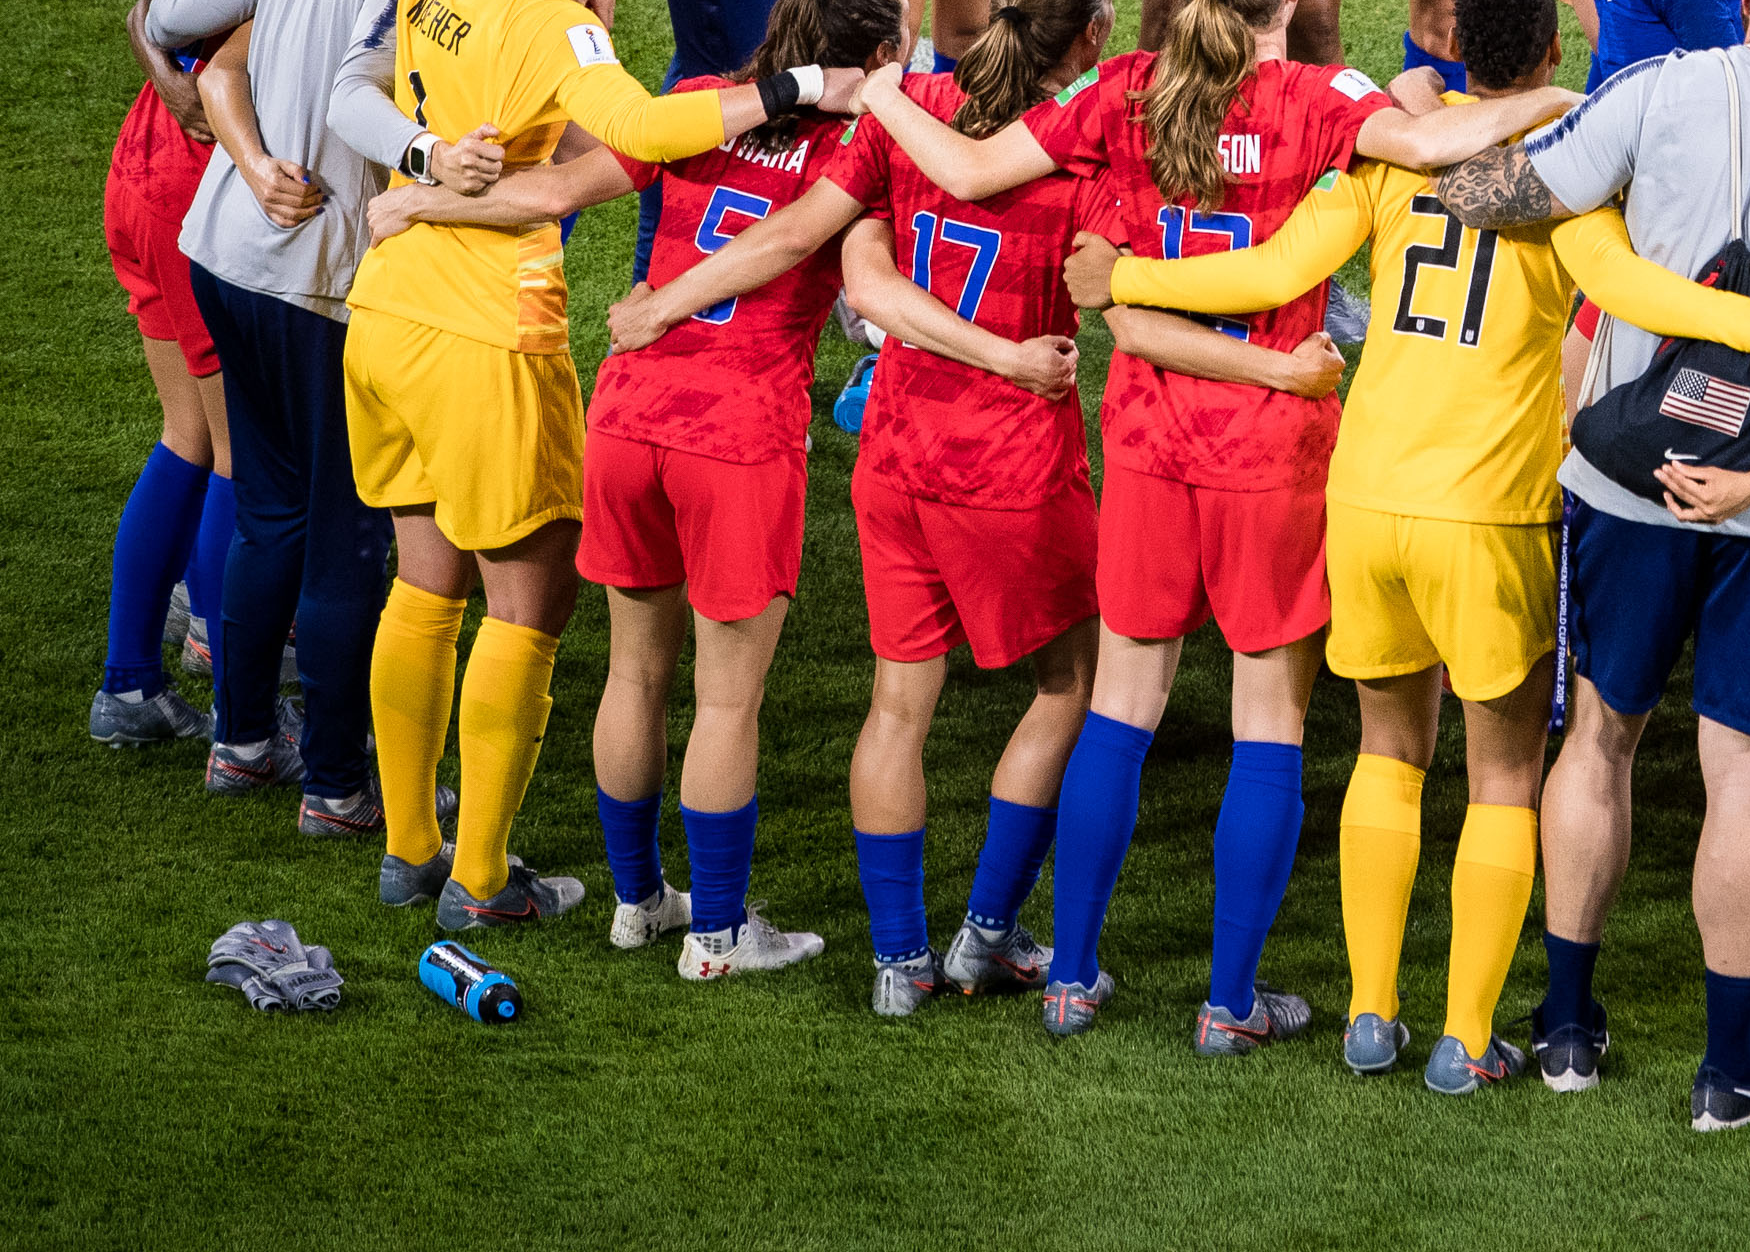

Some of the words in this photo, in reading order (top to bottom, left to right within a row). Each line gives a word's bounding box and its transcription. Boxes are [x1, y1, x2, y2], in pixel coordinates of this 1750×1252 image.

[695, 185, 772, 325] 5
[903, 210, 1002, 350] 17
[1392, 193, 1499, 348] 21
[1558, 626, 1566, 645] CUP
[1559, 591, 1567, 625] WORLD
[1557, 646, 1566, 683] FRANCE
